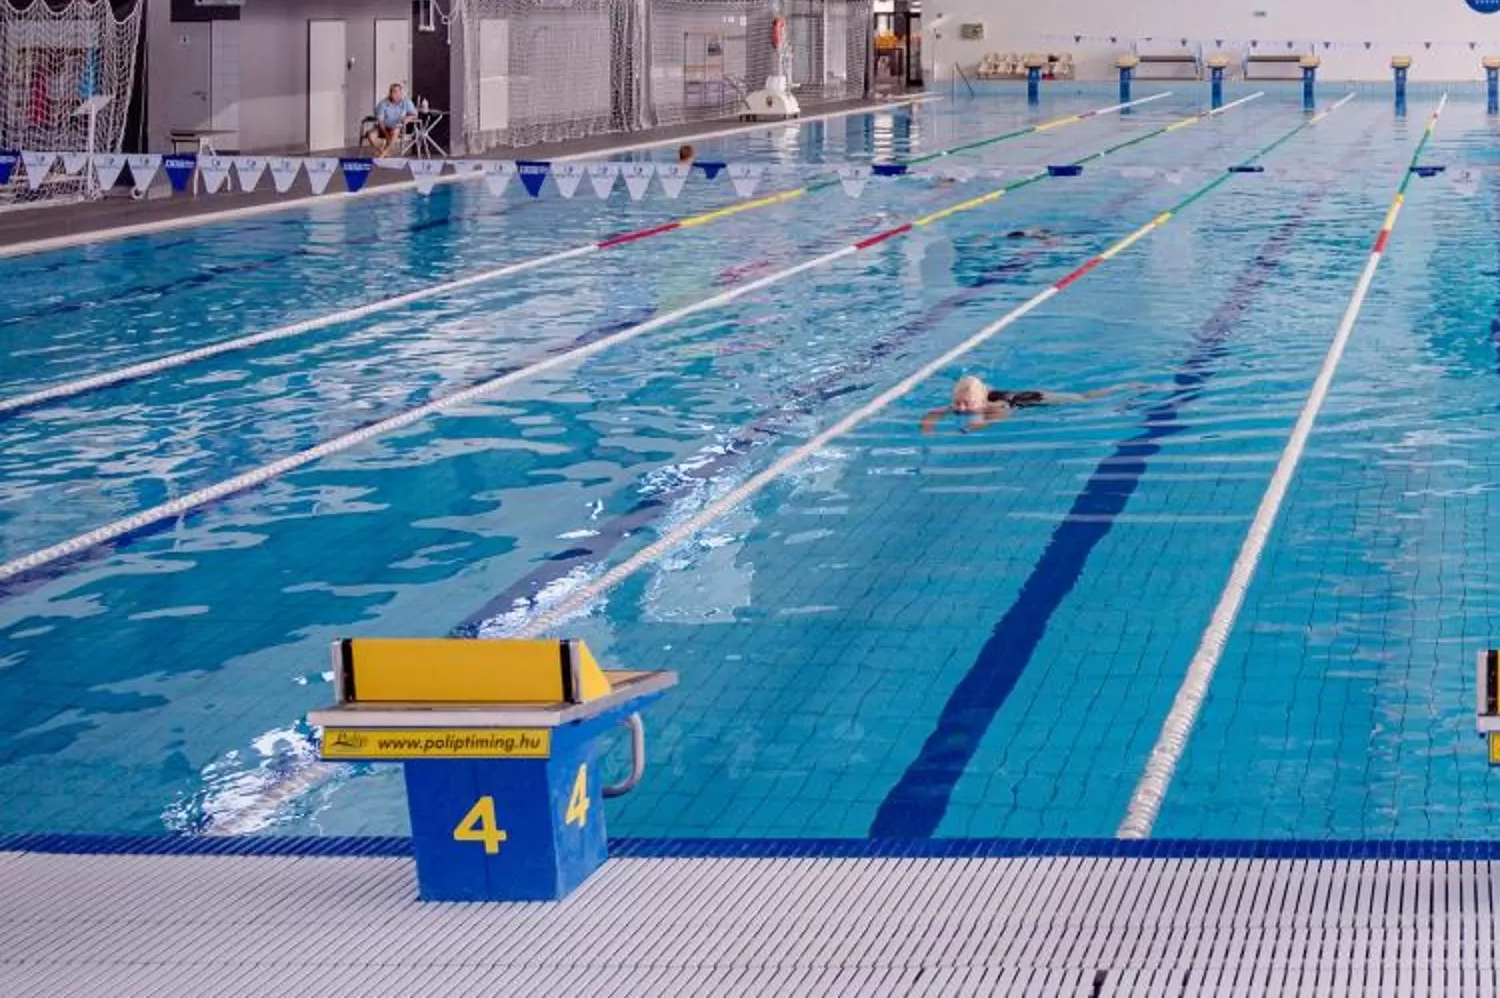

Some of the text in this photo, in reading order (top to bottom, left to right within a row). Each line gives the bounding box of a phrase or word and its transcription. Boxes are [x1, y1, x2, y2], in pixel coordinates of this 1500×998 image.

[378, 734, 540, 752] www.poliptiming.hu
[453, 795, 507, 854] 4
[564, 762, 590, 828] 4
